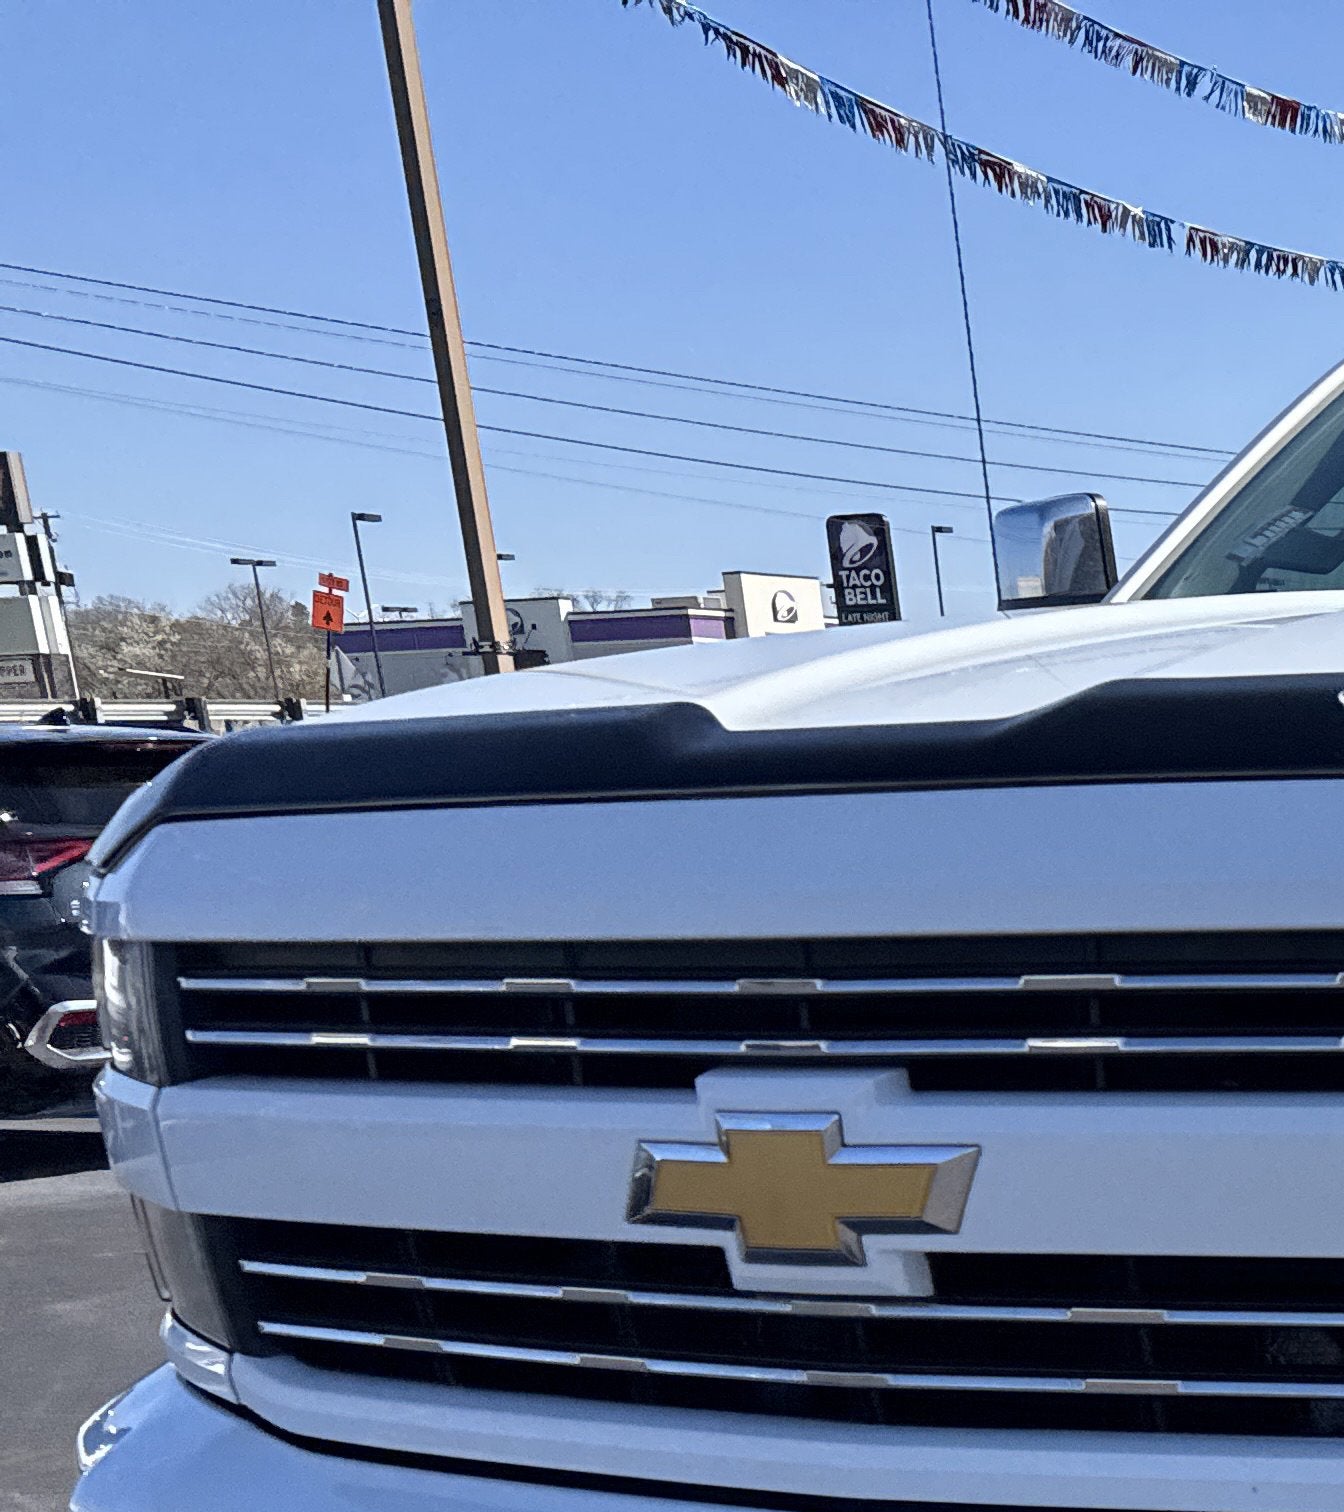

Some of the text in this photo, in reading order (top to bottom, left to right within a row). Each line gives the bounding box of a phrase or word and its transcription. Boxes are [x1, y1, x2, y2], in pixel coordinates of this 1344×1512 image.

[838, 568, 885, 588] TACO
[844, 587, 887, 605] BELL
[841, 612, 862, 623] LATE
